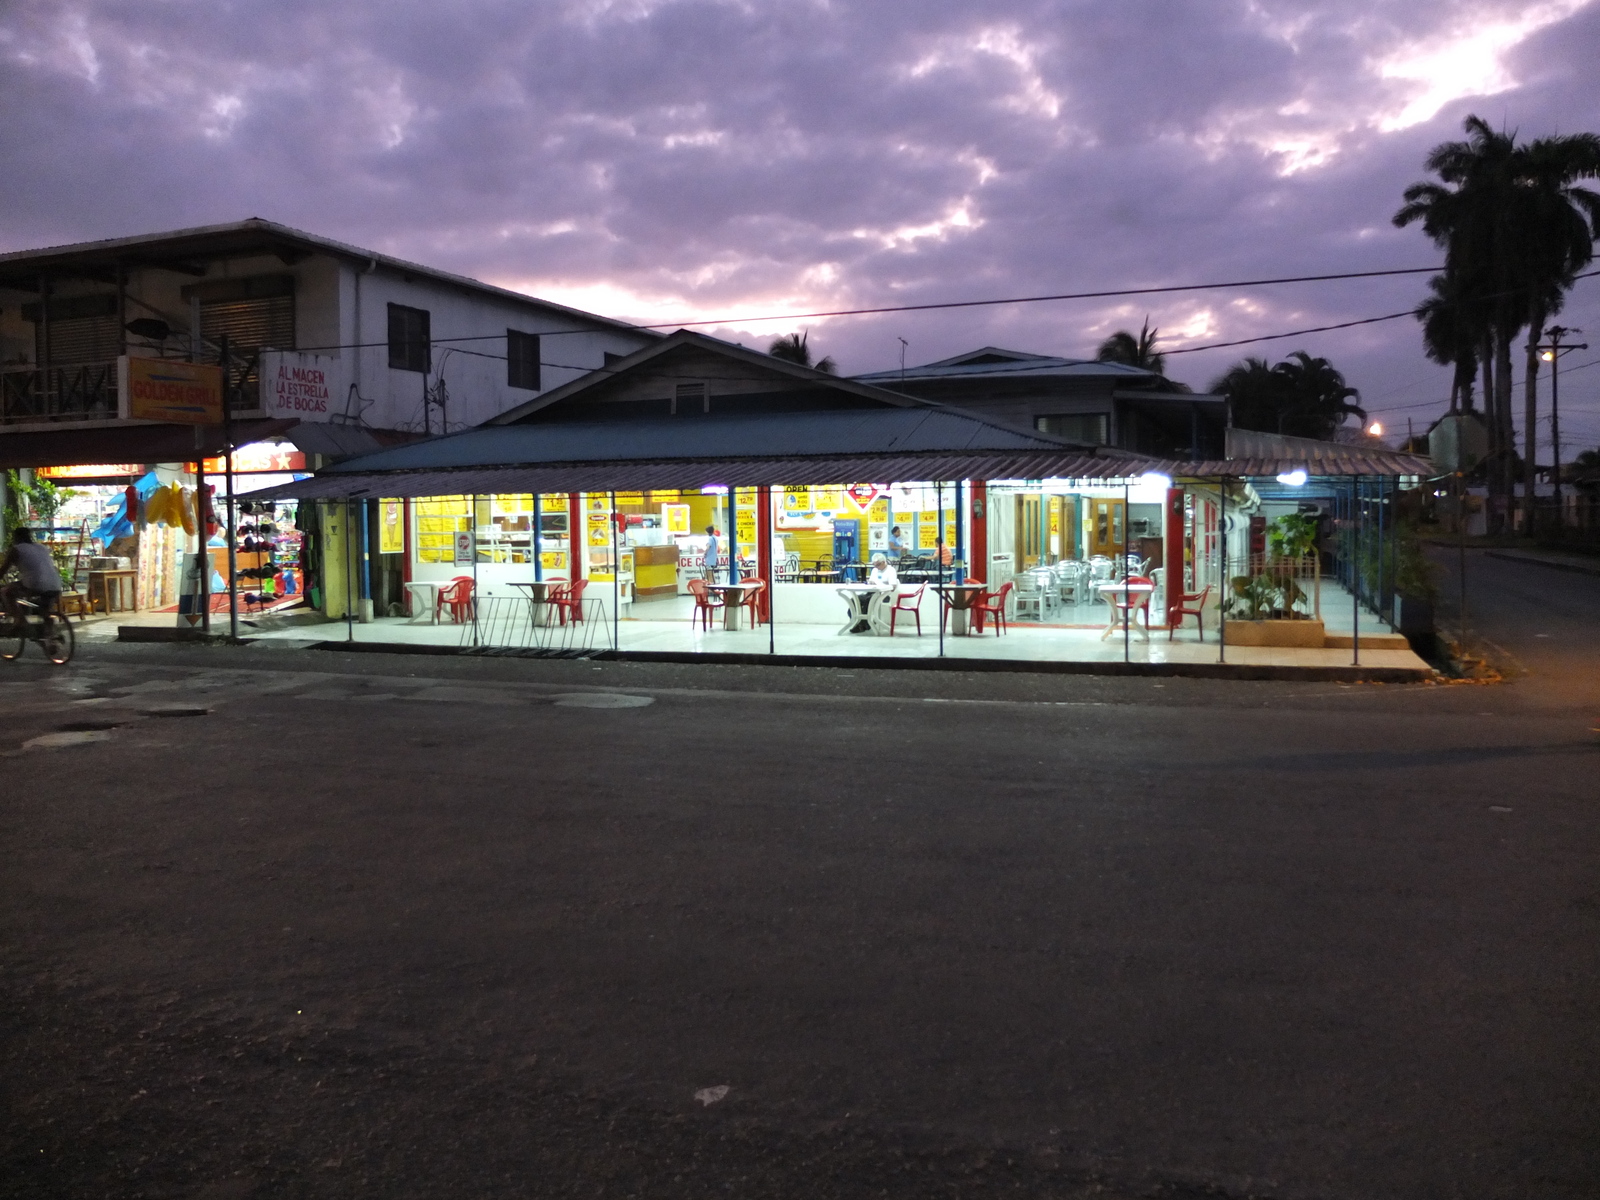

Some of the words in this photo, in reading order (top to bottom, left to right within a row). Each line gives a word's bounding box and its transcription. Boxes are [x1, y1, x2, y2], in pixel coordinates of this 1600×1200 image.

[278, 366, 325, 384] ALMACEN
[133, 380, 184, 402] GOLDEN
[186, 387, 220, 406] GRILL
[276, 381, 286, 394] LA
[288, 383, 329, 399] ESTRELLA
[279, 395, 292, 409] DE
[294, 397, 327, 412] BOCAS
[678, 557, 692, 567] ICE
